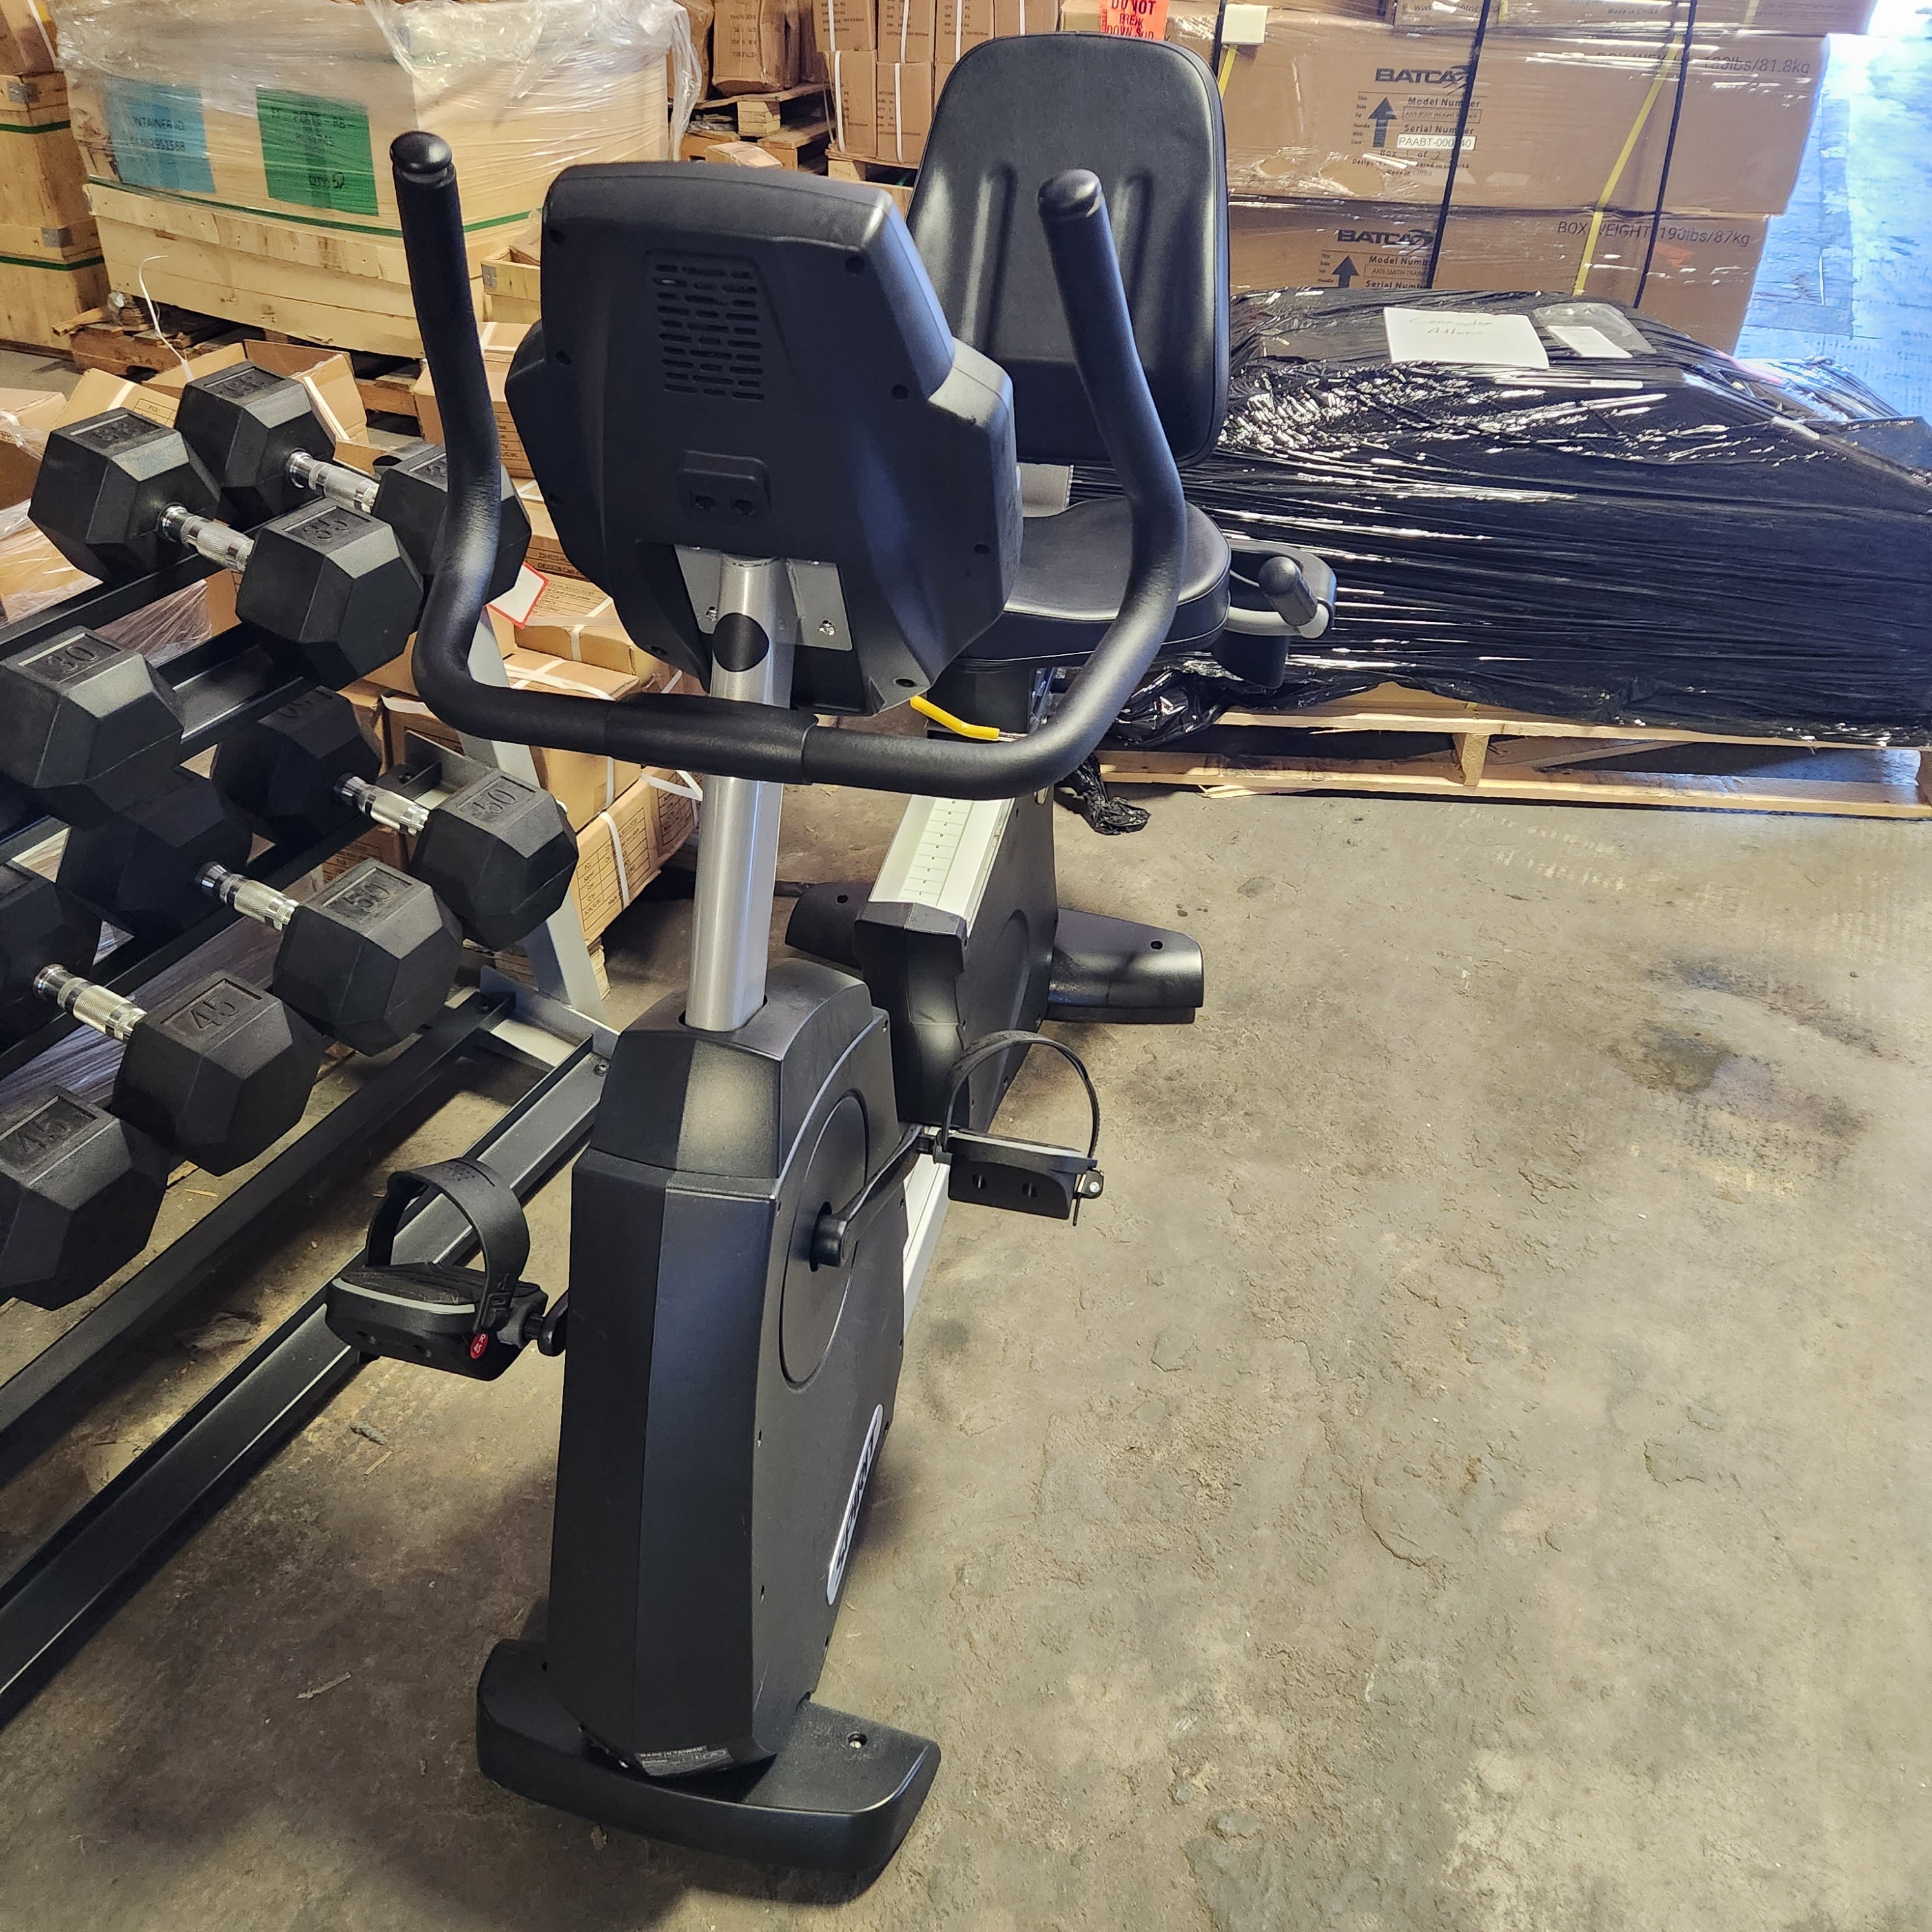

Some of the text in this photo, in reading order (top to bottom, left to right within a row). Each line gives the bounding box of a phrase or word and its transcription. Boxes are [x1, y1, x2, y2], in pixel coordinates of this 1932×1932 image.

[1407, 97, 1481, 108] Model Numer
[1398, 136, 1472, 148] PAABT-00040
[1404, 124, 1474, 135] Serial Numer
[1380, 149, 1397, 158] Box
[1557, 221, 1751, 247] BOX EIGHT 190lbs/87kg
[1369, 256, 1399, 265] Model
[1366, 280, 1393, 288] Serial
[303, 517, 350, 543] 35
[47, 645, 97, 673] 30
[475, 788, 517, 821] 50
[342, 881, 394, 915] 50
[189, 991, 239, 1029] 45
[15, 1111, 72, 1149] 45
